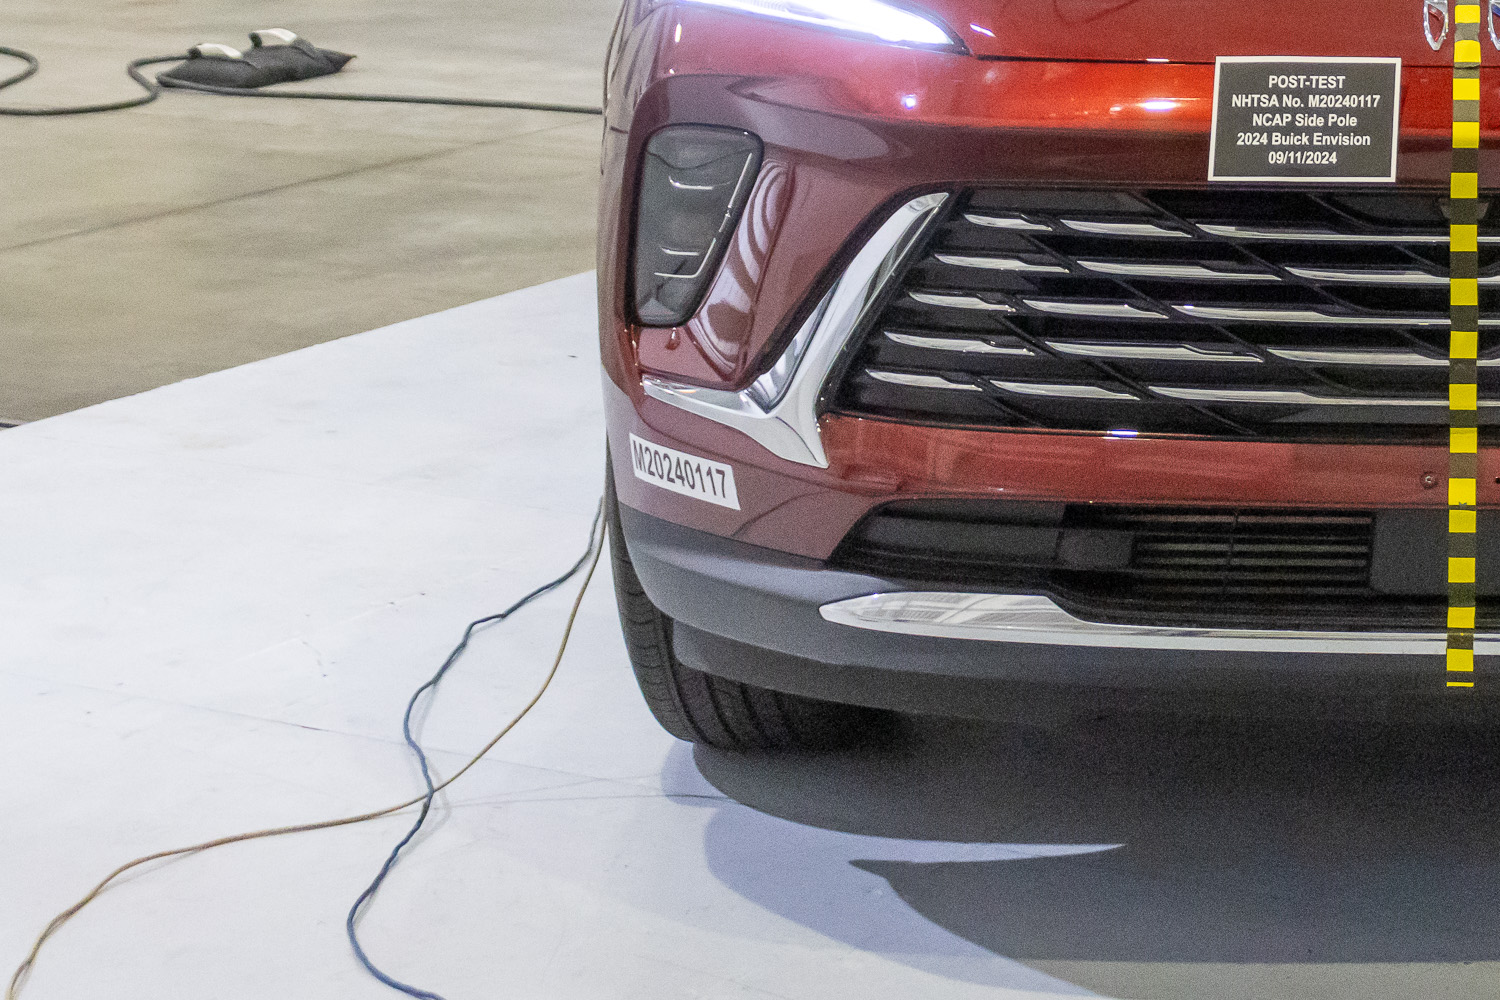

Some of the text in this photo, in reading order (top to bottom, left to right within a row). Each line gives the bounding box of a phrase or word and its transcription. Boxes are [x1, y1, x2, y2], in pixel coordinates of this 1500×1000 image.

[1268, 75, 1346, 89] POST-TEST
[1231, 94, 1381, 108] NHTSA No. M20240117
[1252, 113, 1358, 127] NCAP Side Pole
[1236, 132, 1371, 146] 2024 Buick Envision
[1268, 150, 1338, 165] 09/11/2024
[632, 439, 726, 498] M20240117
